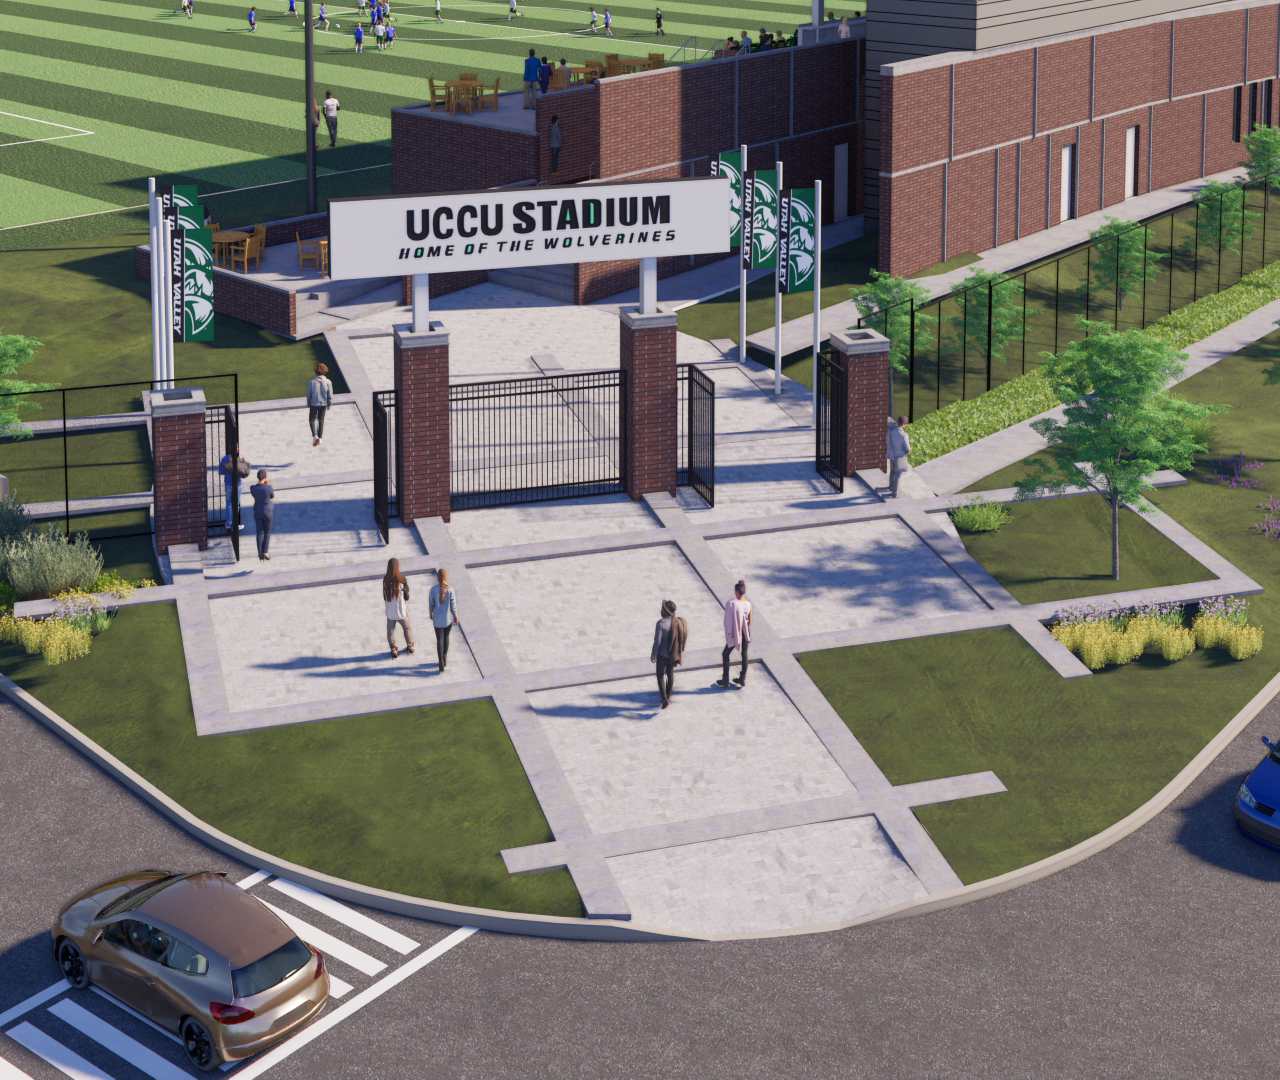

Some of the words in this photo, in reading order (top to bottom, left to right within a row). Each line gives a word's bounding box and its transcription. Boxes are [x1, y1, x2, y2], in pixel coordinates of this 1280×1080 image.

[406, 204, 503, 241] UCCU
[512, 195, 671, 234] STADIUM
[780, 197, 789, 234] UTAH
[173, 238, 182, 277] UTAH
[399, 244, 455, 260] HOME
[464, 242, 488, 255] OF
[497, 239, 534, 253] THE
[544, 230, 676, 250] WOLVERINES
[743, 217, 752, 264] VALLEY
[779, 237, 788, 286] VALLEY
[173, 282, 182, 336] VALLEY
